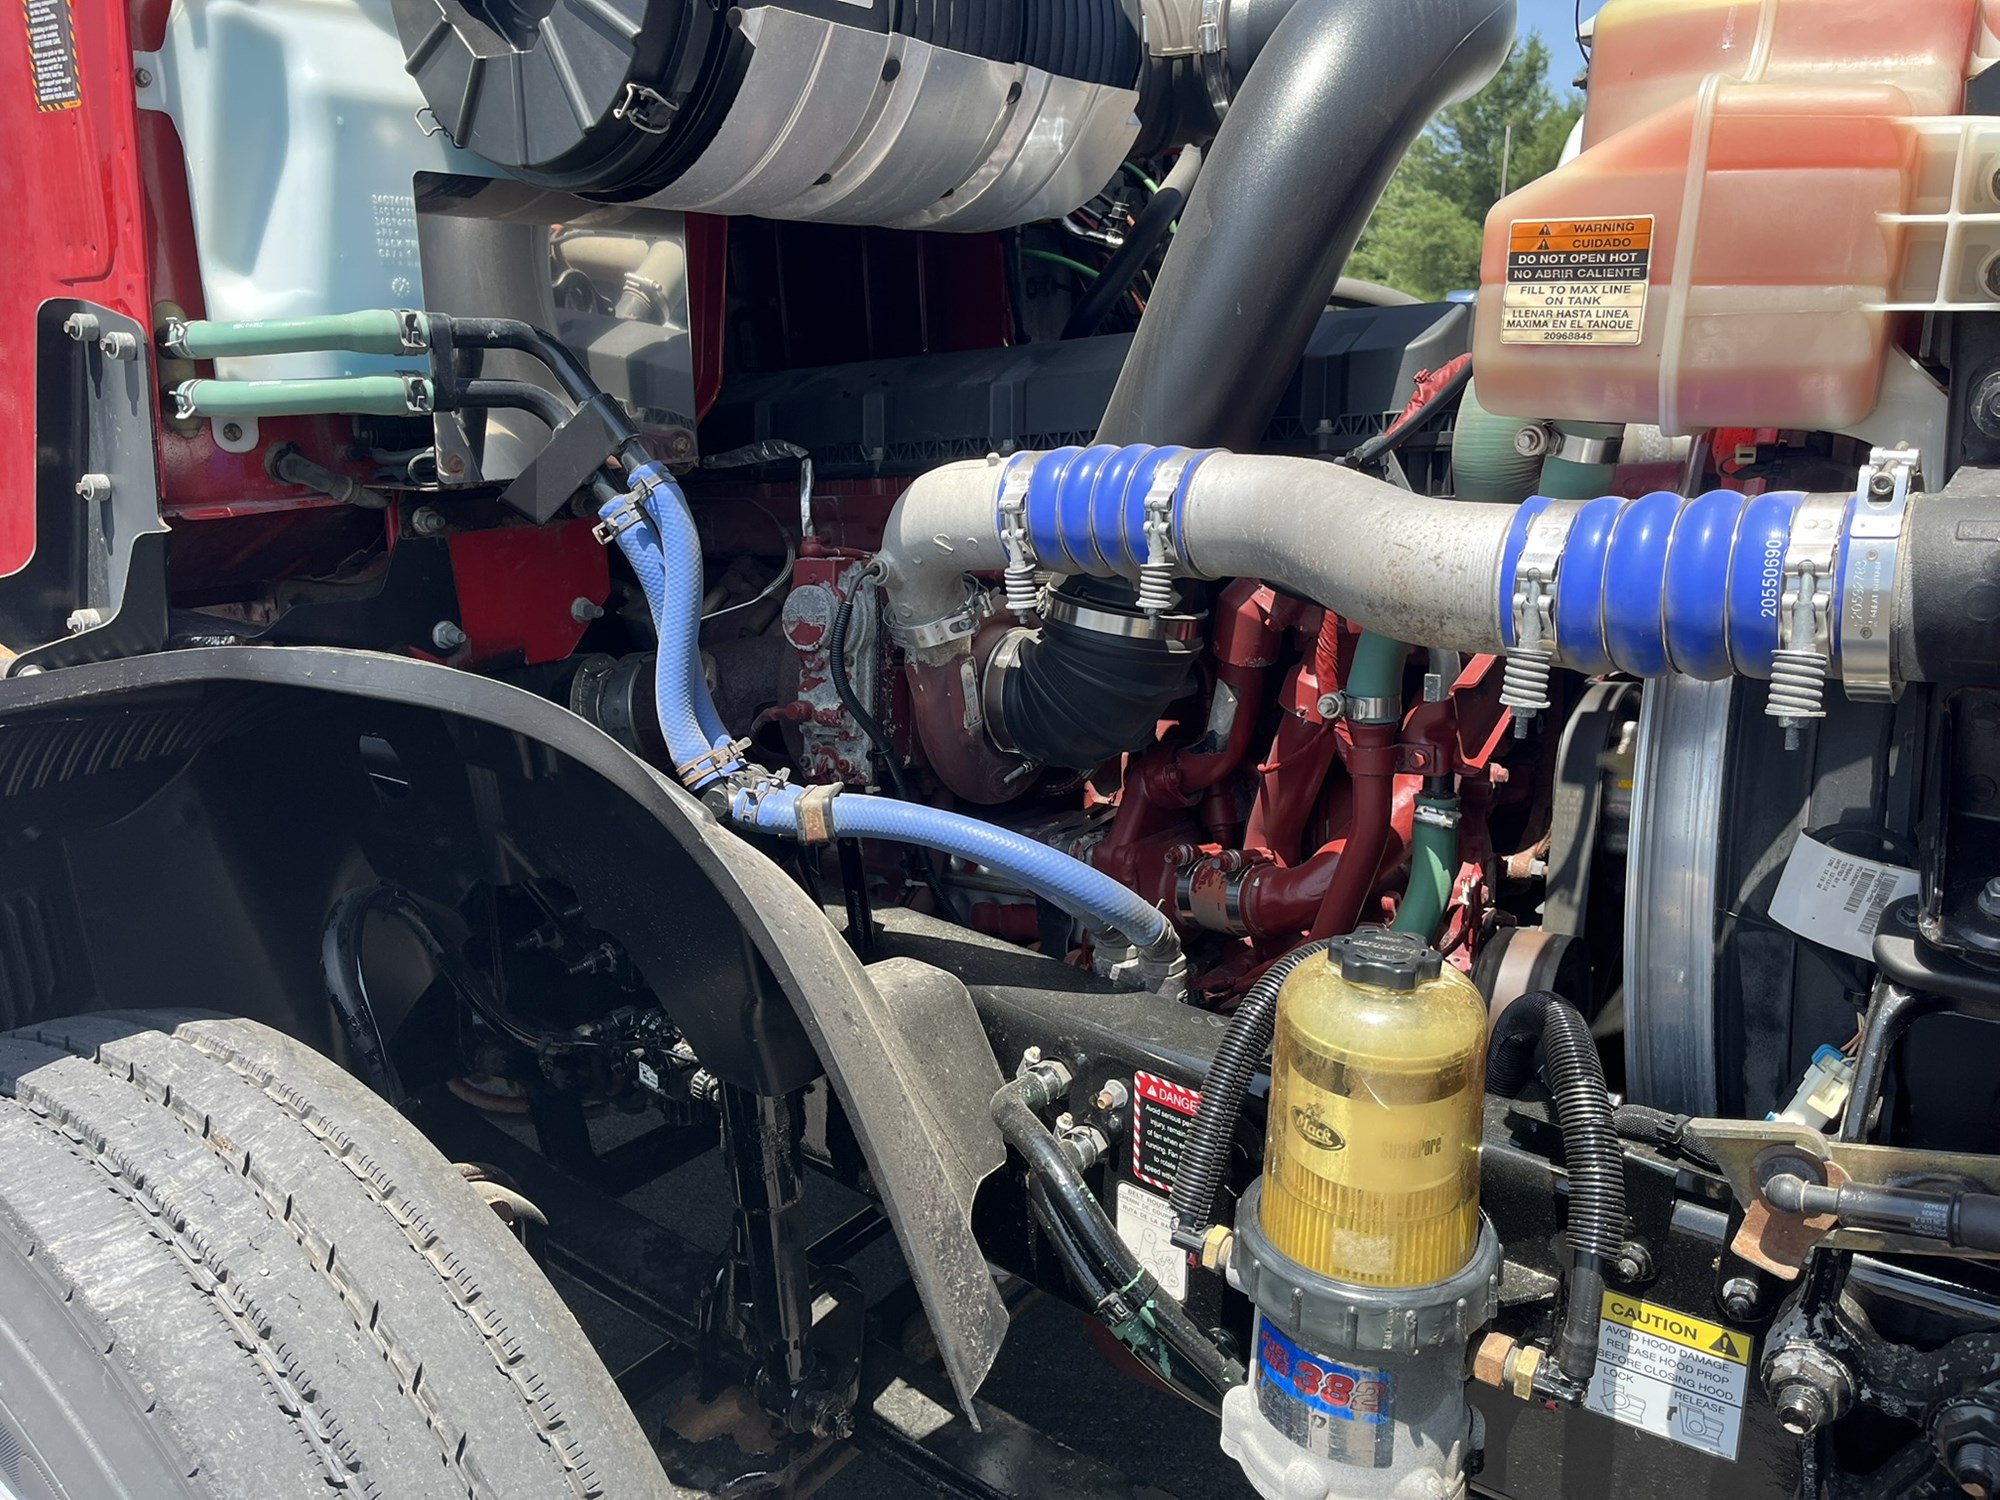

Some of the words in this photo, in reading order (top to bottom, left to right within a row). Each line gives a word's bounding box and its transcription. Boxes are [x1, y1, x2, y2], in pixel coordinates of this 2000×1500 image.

[1574, 222, 1635, 233] WARNING
[1572, 238, 1632, 248] CUIDADO
[1518, 255, 1536, 264] DO
[1540, 254, 1566, 264] NOT
[1569, 253, 1605, 263] OPEN
[1610, 252, 1638, 263] HOT
[1514, 269, 1532, 279] NO
[1535, 269, 1573, 279] ABRIR
[1577, 267, 1640, 278] CALIENTE
[1520, 286, 1545, 295] FILL
[1550, 286, 1566, 295] TO
[1570, 286, 1598, 295] MAX
[1602, 285, 1632, 294] LINE
[1545, 297, 1564, 305] ON
[1568, 296, 1601, 305] TANK
[1512, 310, 1553, 318] LLENAR
[1556, 310, 1592, 318] HASTA
[1596, 309, 1629, 318] LINEA
[1506, 320, 1549, 329] MAXIMA
[1552, 320, 1567, 329] EN
[1570, 320, 1583, 328] EL
[1587, 320, 1633, 330] TANQUE
[1543, 331, 1593, 341] 20968845
[1761, 539, 1782, 618] 20550690
[1159, 1089, 1198, 1112] DANGE
[1145, 1104, 1161, 1114] Avoid
[1161, 1111, 1182, 1124] serious
[1147, 1128, 1152, 1136] of
[1153, 1131, 1163, 1140] fan
[1163, 1136, 1178, 1146] when
[1296, 1114, 1334, 1146] Mack
[1167, 1149, 1179, 1159] Fan
[1144, 1164, 1161, 1175] speed
[1161, 1171, 1176, 1181] witho
[1161, 1159, 1176, 1170] rotate
[1127, 1188, 1143, 1198] BELT
[1117, 1193, 1140, 1205] CHEMIN
[1151, 1209, 1171, 1220] COURR
[1121, 1204, 1138, 1214] RUTA
[1610, 1302, 1698, 1341] CAUTION
[1605, 1324, 1640, 1342] AVOID
[1642, 1337, 1676, 1354] HOOD
[1679, 1350, 1732, 1374] DAMAGE.
[1606, 1338, 1656, 1362] RELEASE
[1659, 1356, 1694, 1374] HOOD
[1696, 1367, 1730, 1385] PROP
[1597, 1348, 1642, 1371] BEFORE
[1644, 1364, 1695, 1389] CLOSING
[1698, 1383, 1736, 1402] HOOD.
[1603, 1366, 1634, 1384] LOCK
[1294, 1360, 1386, 1413] 382
[1674, 1391, 1726, 1415] RELEASE
